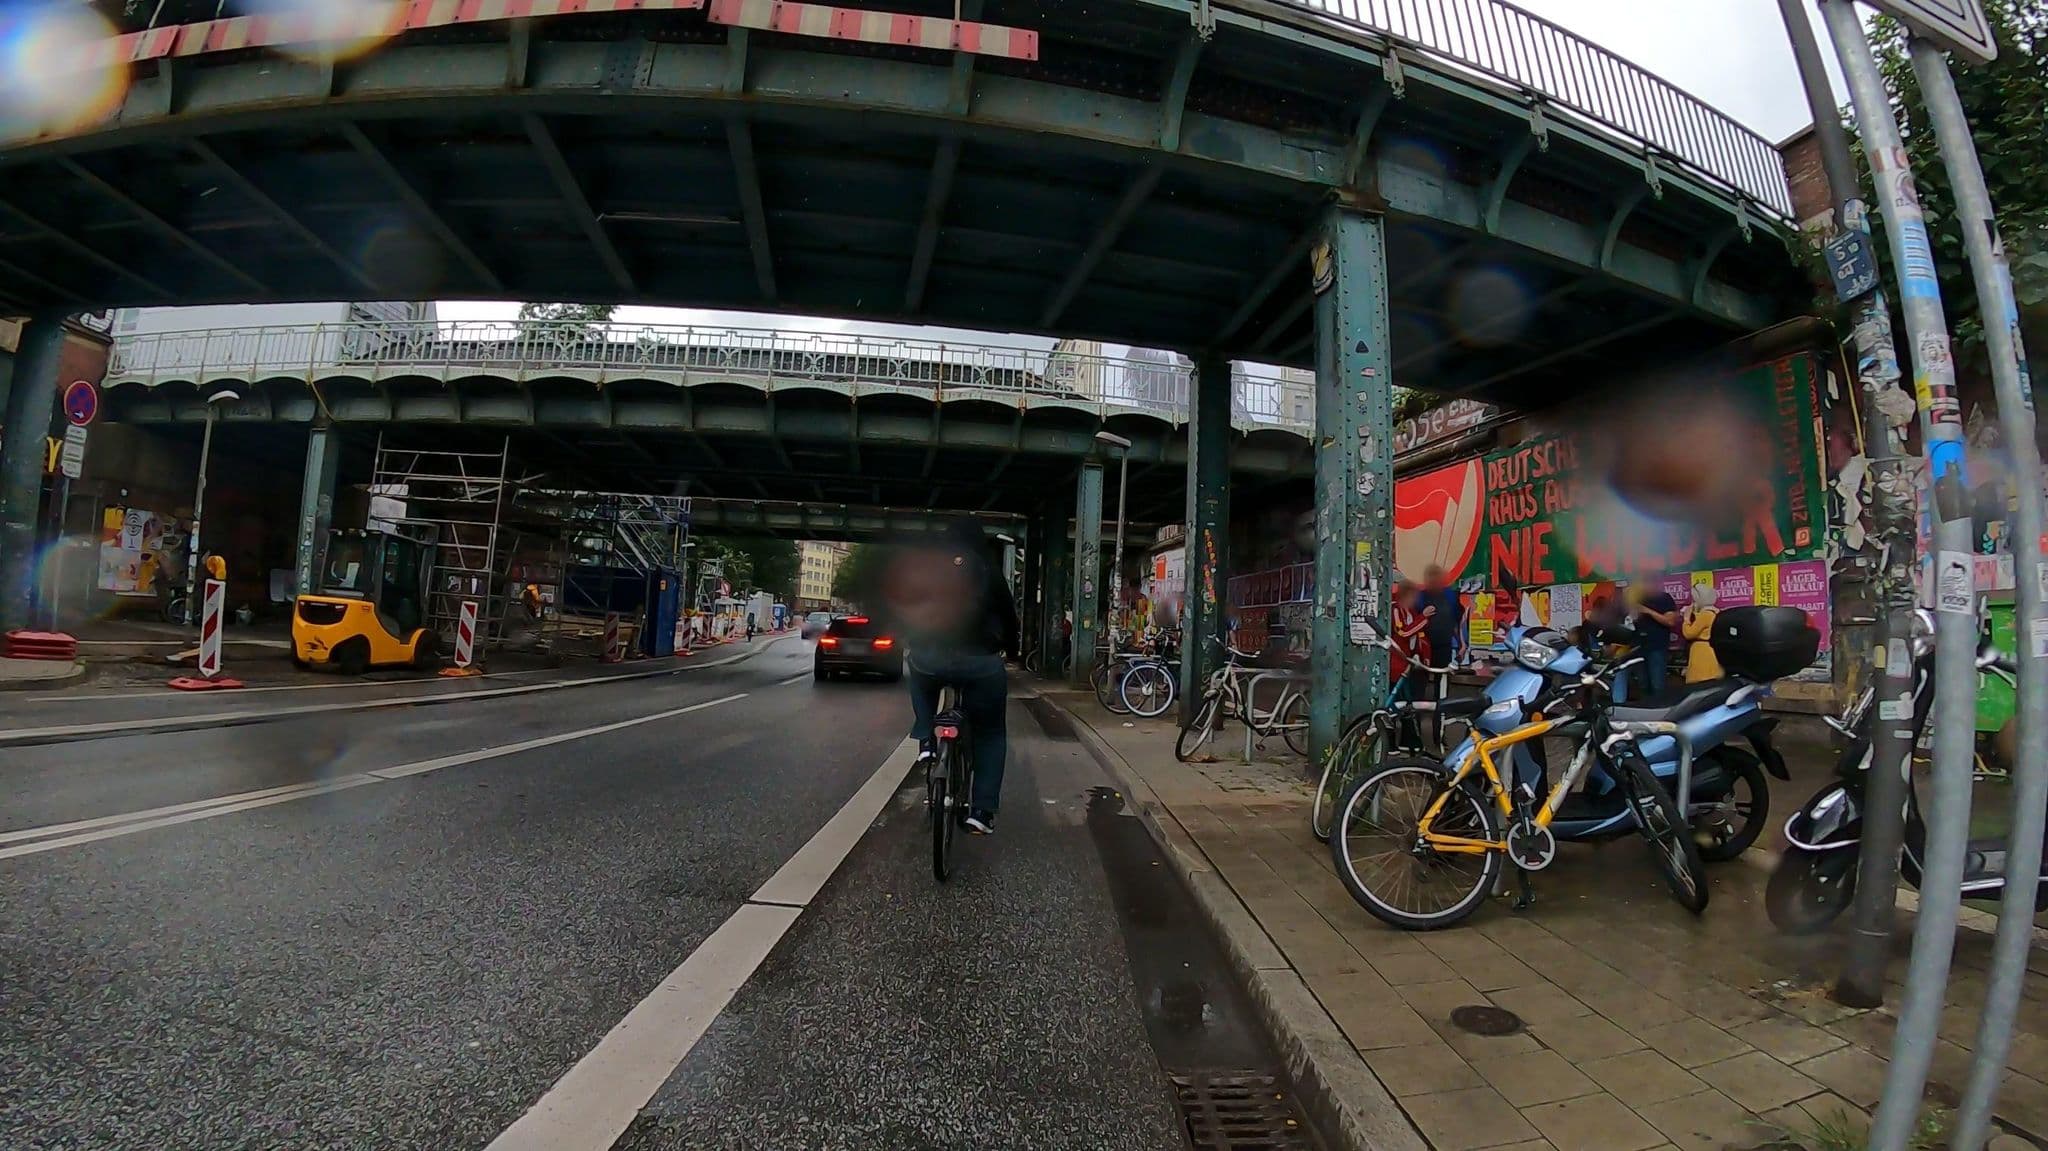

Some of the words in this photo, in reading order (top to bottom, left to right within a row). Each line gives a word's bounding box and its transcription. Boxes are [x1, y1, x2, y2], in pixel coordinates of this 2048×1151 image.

[1489, 483, 1538, 527] RAUS
[1544, 479, 1582, 514] AU
[1490, 521, 1555, 590] NIE
[1781, 581, 1825, 593] VERKAUF
[1786, 573, 1820, 584] LAGER-
